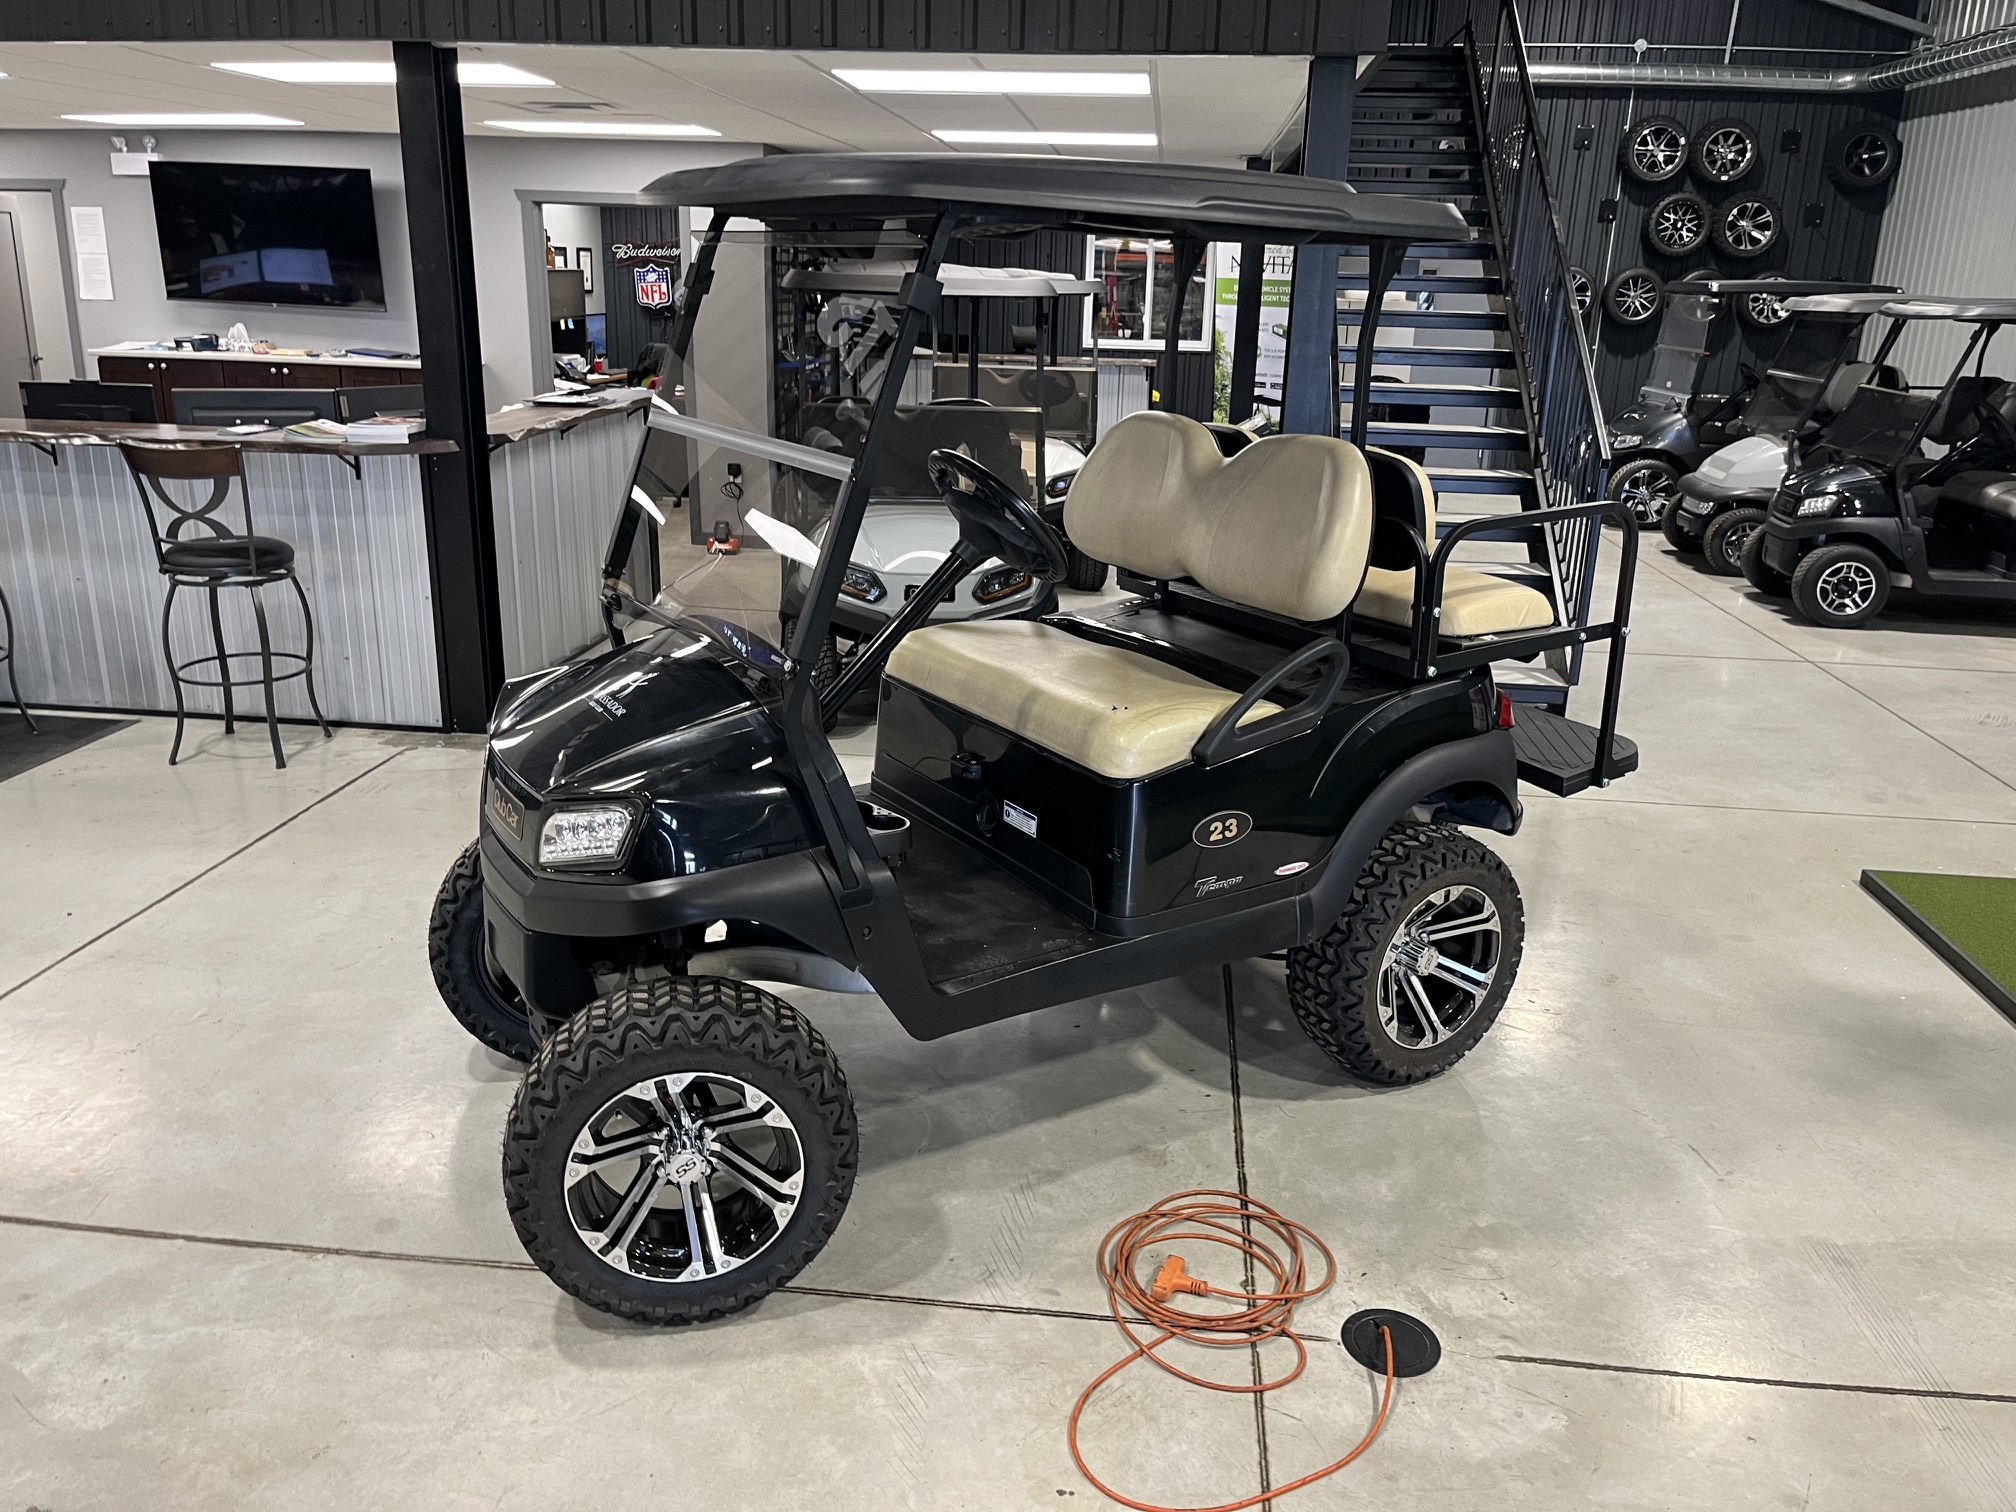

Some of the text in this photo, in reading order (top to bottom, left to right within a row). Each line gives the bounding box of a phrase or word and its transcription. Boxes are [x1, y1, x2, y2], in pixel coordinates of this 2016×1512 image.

[611, 244, 681, 259] Budweiser
[640, 284, 667, 303] NFL
[1209, 818, 1238, 841] 23
